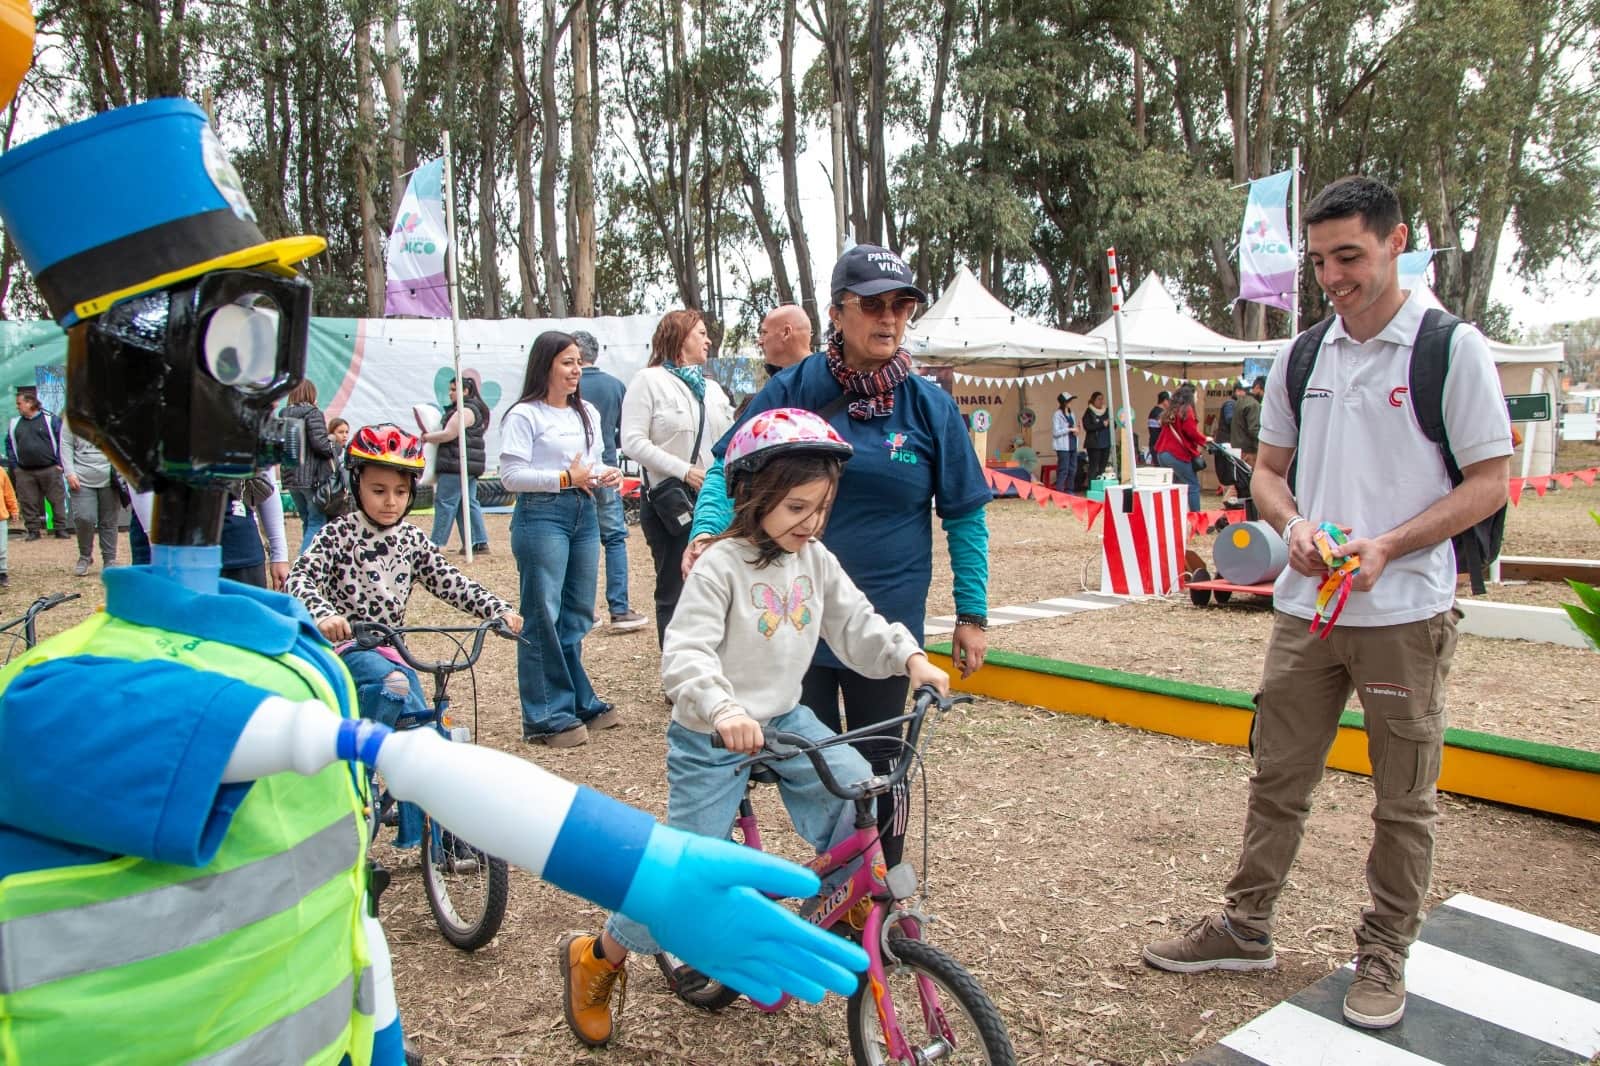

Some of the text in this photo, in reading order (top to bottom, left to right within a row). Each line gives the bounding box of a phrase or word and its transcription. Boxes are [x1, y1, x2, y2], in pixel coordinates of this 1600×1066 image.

[878, 262, 904, 275] VIAL
[956, 395, 1003, 405] INARIA
[890, 451, 917, 464] PICO
